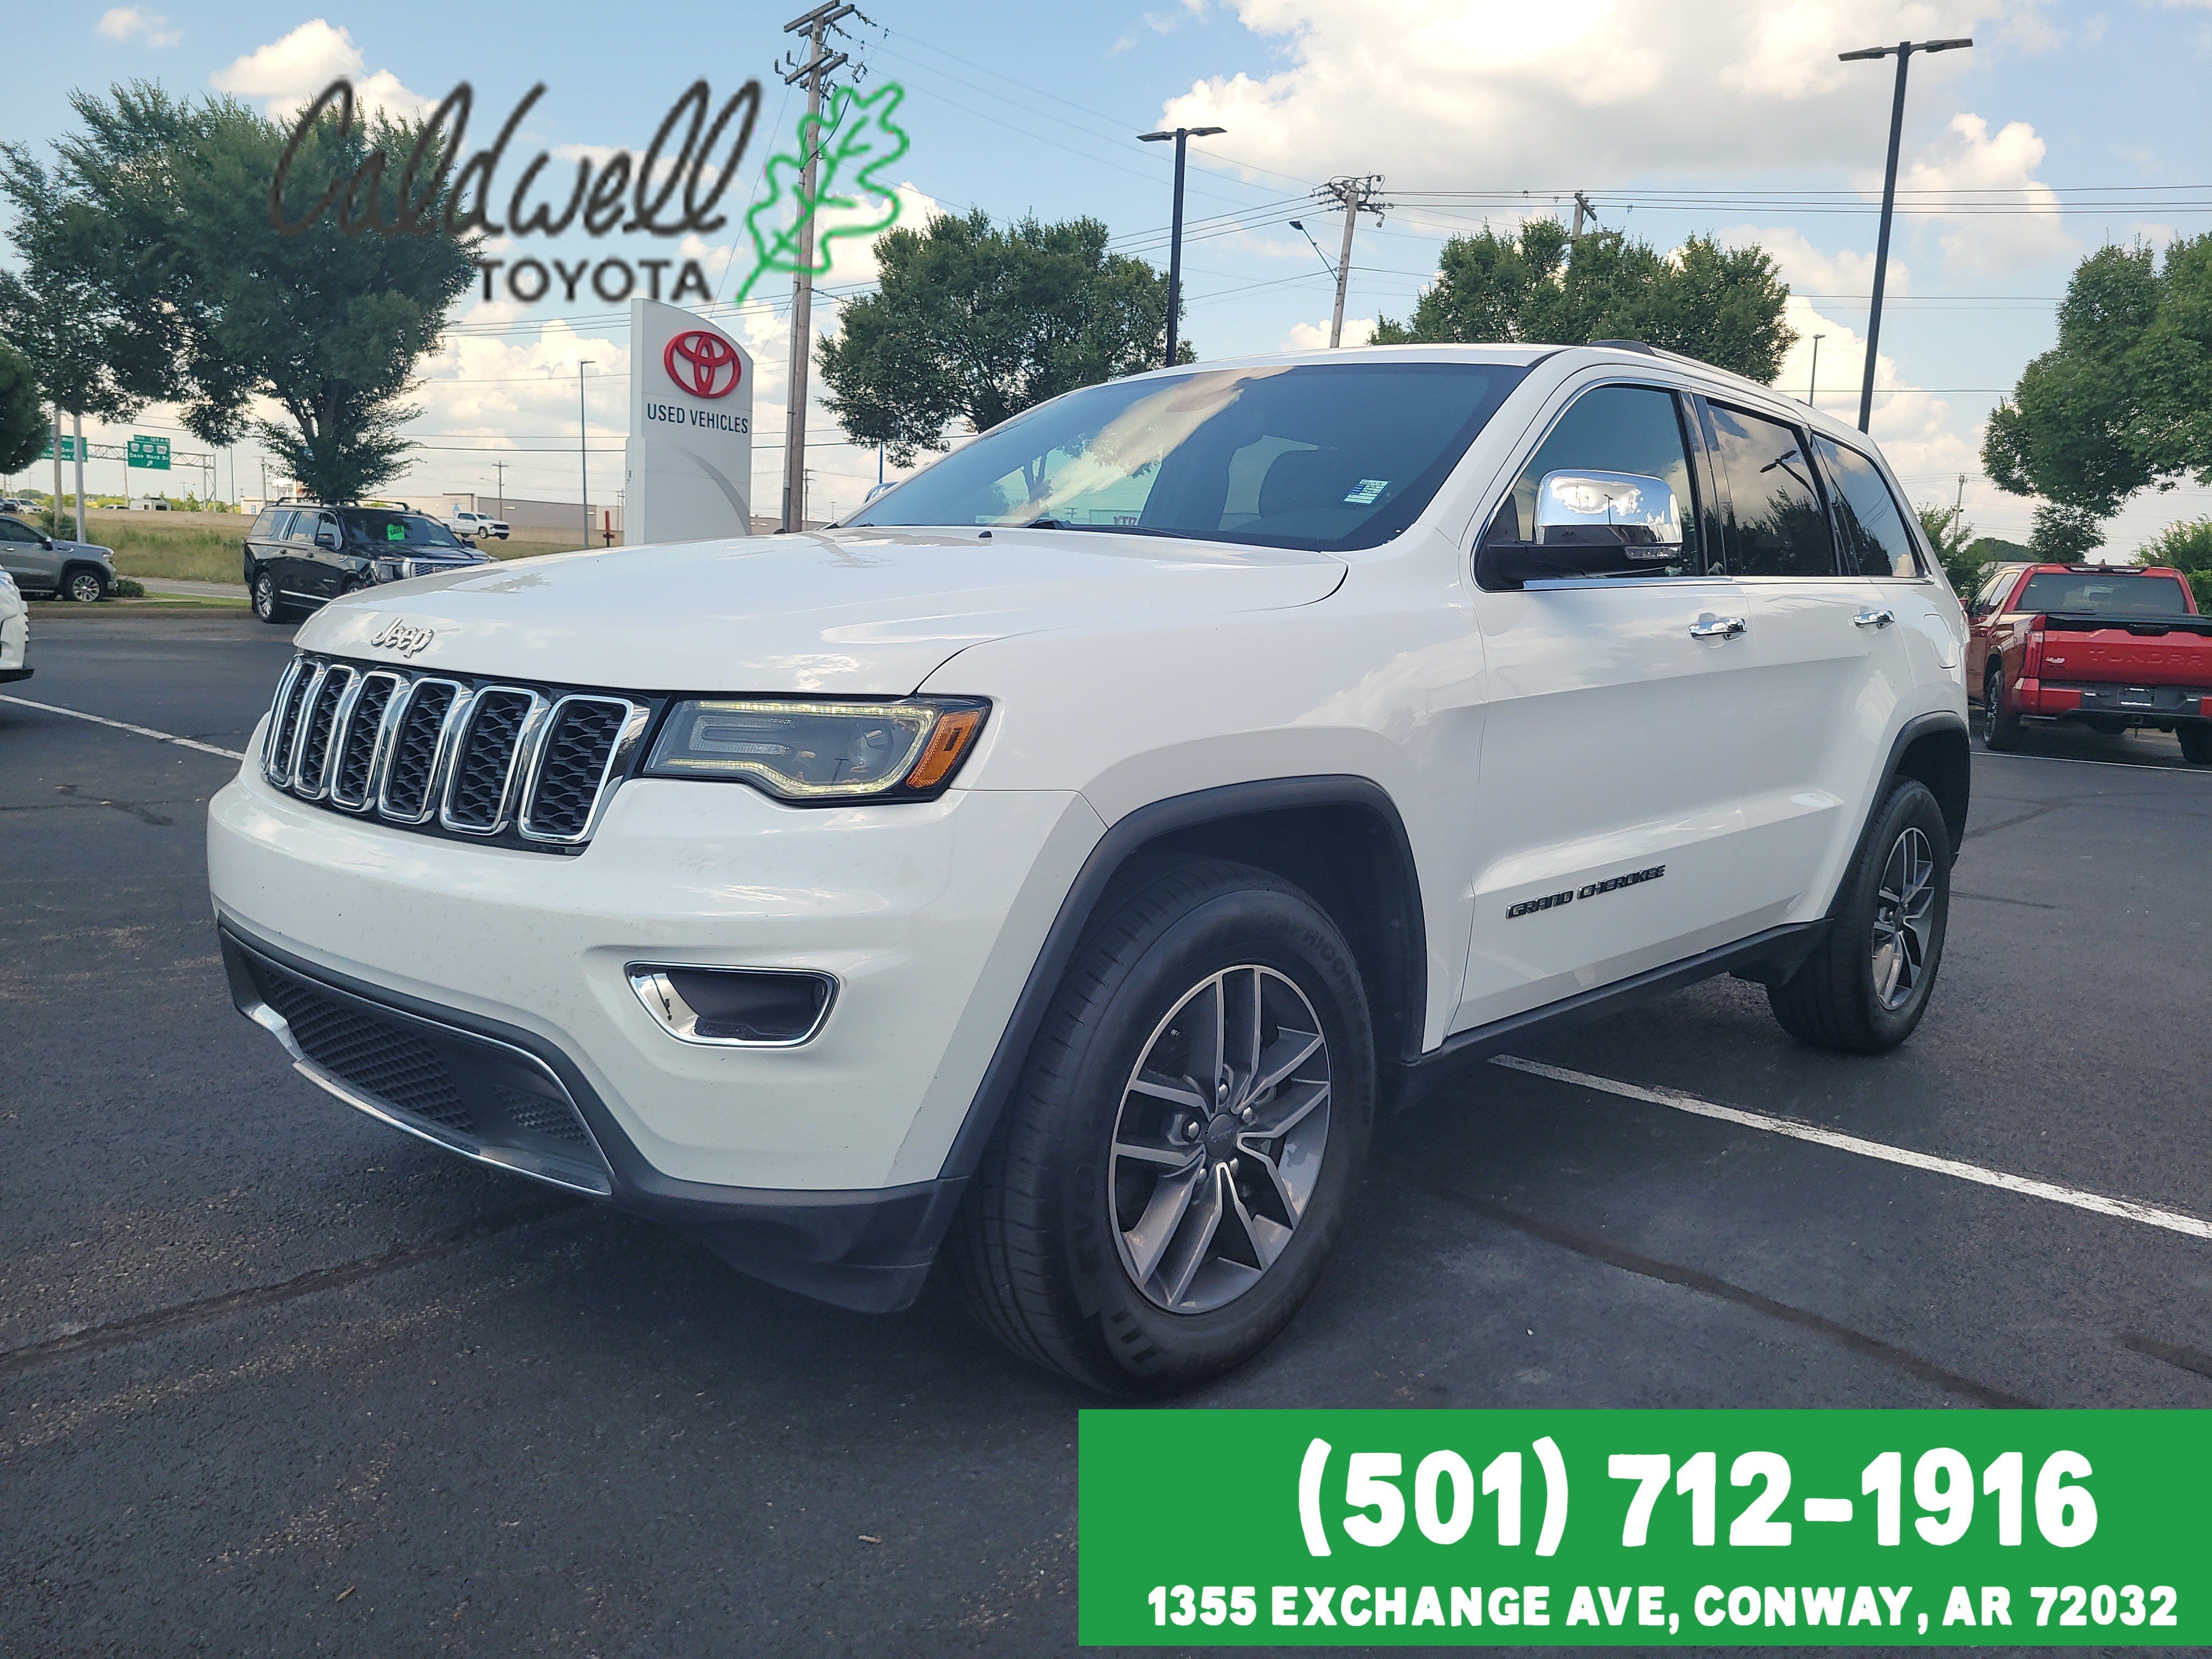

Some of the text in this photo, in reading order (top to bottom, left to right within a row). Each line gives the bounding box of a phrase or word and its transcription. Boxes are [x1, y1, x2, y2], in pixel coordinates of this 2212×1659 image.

[647, 403, 748, 434] USED VEHICLES
[371, 617, 435, 658] Jeep
[1505, 864, 1666, 919] GRAND CHEROKEE
